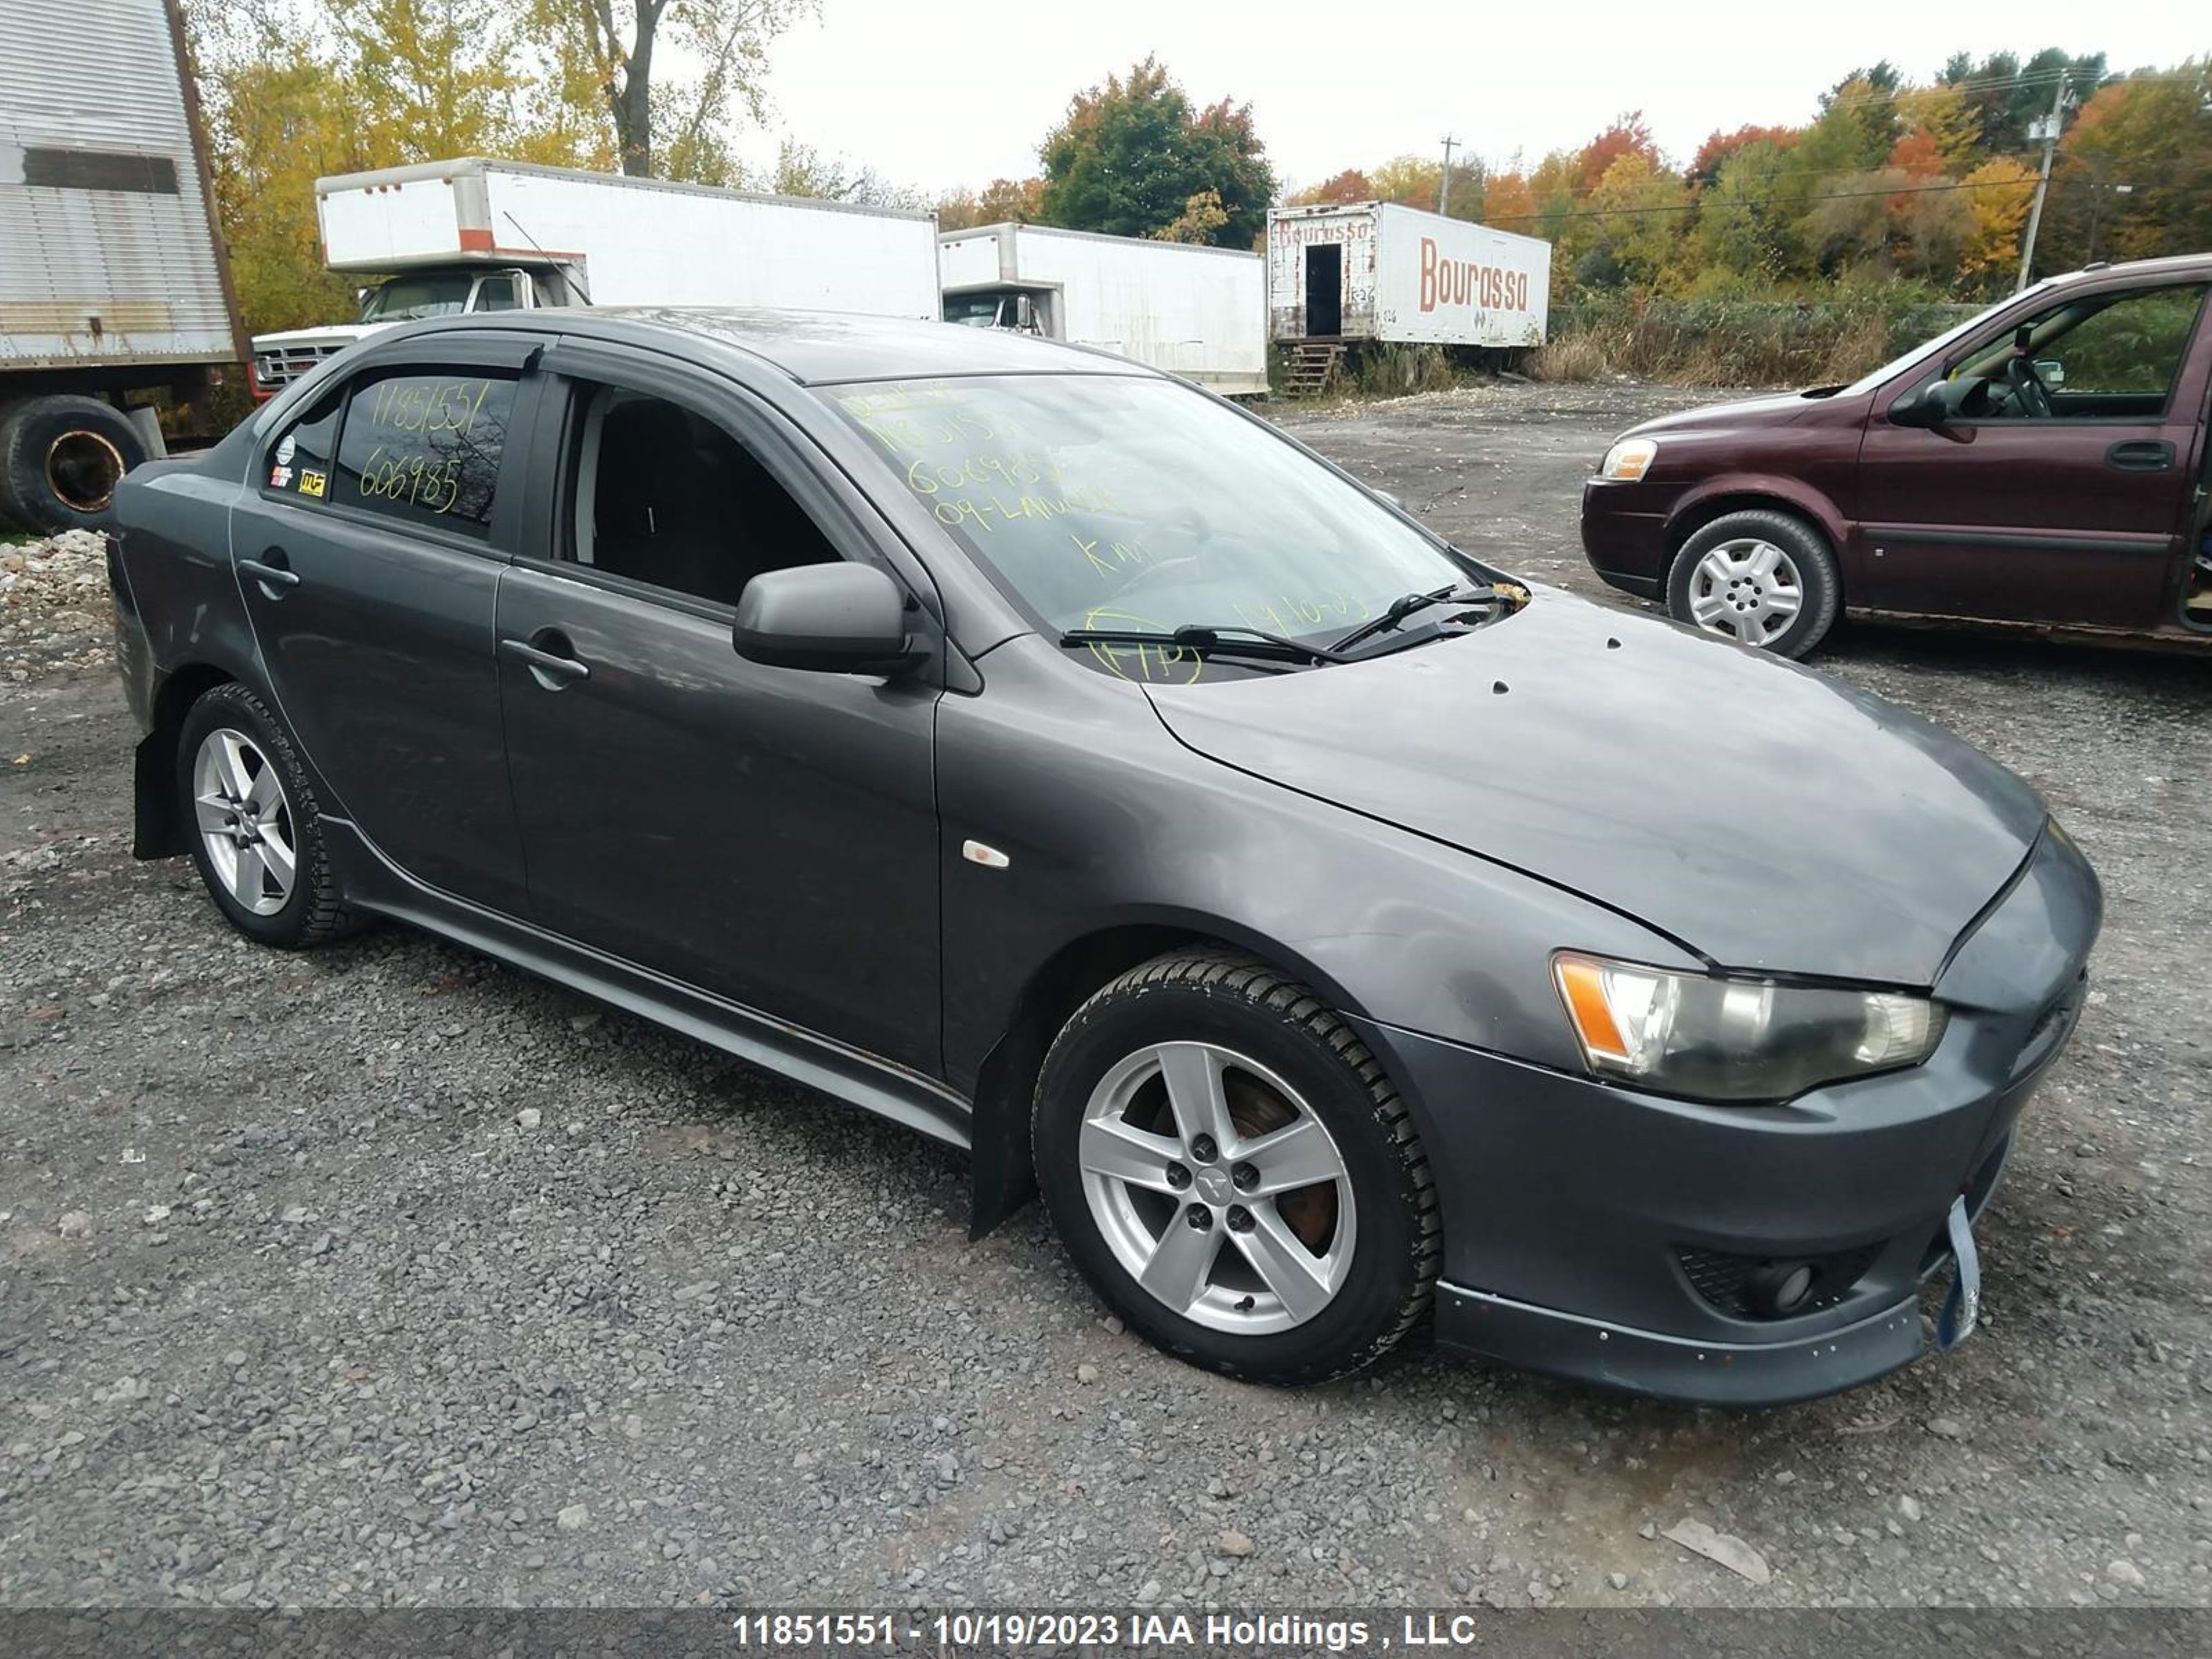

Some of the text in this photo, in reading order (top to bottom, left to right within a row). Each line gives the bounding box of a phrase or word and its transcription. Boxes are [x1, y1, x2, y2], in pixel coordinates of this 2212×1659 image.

[1420, 237, 1527, 312] Bourassa
[373, 382, 491, 436] 11851551
[360, 447, 461, 514] 606985
